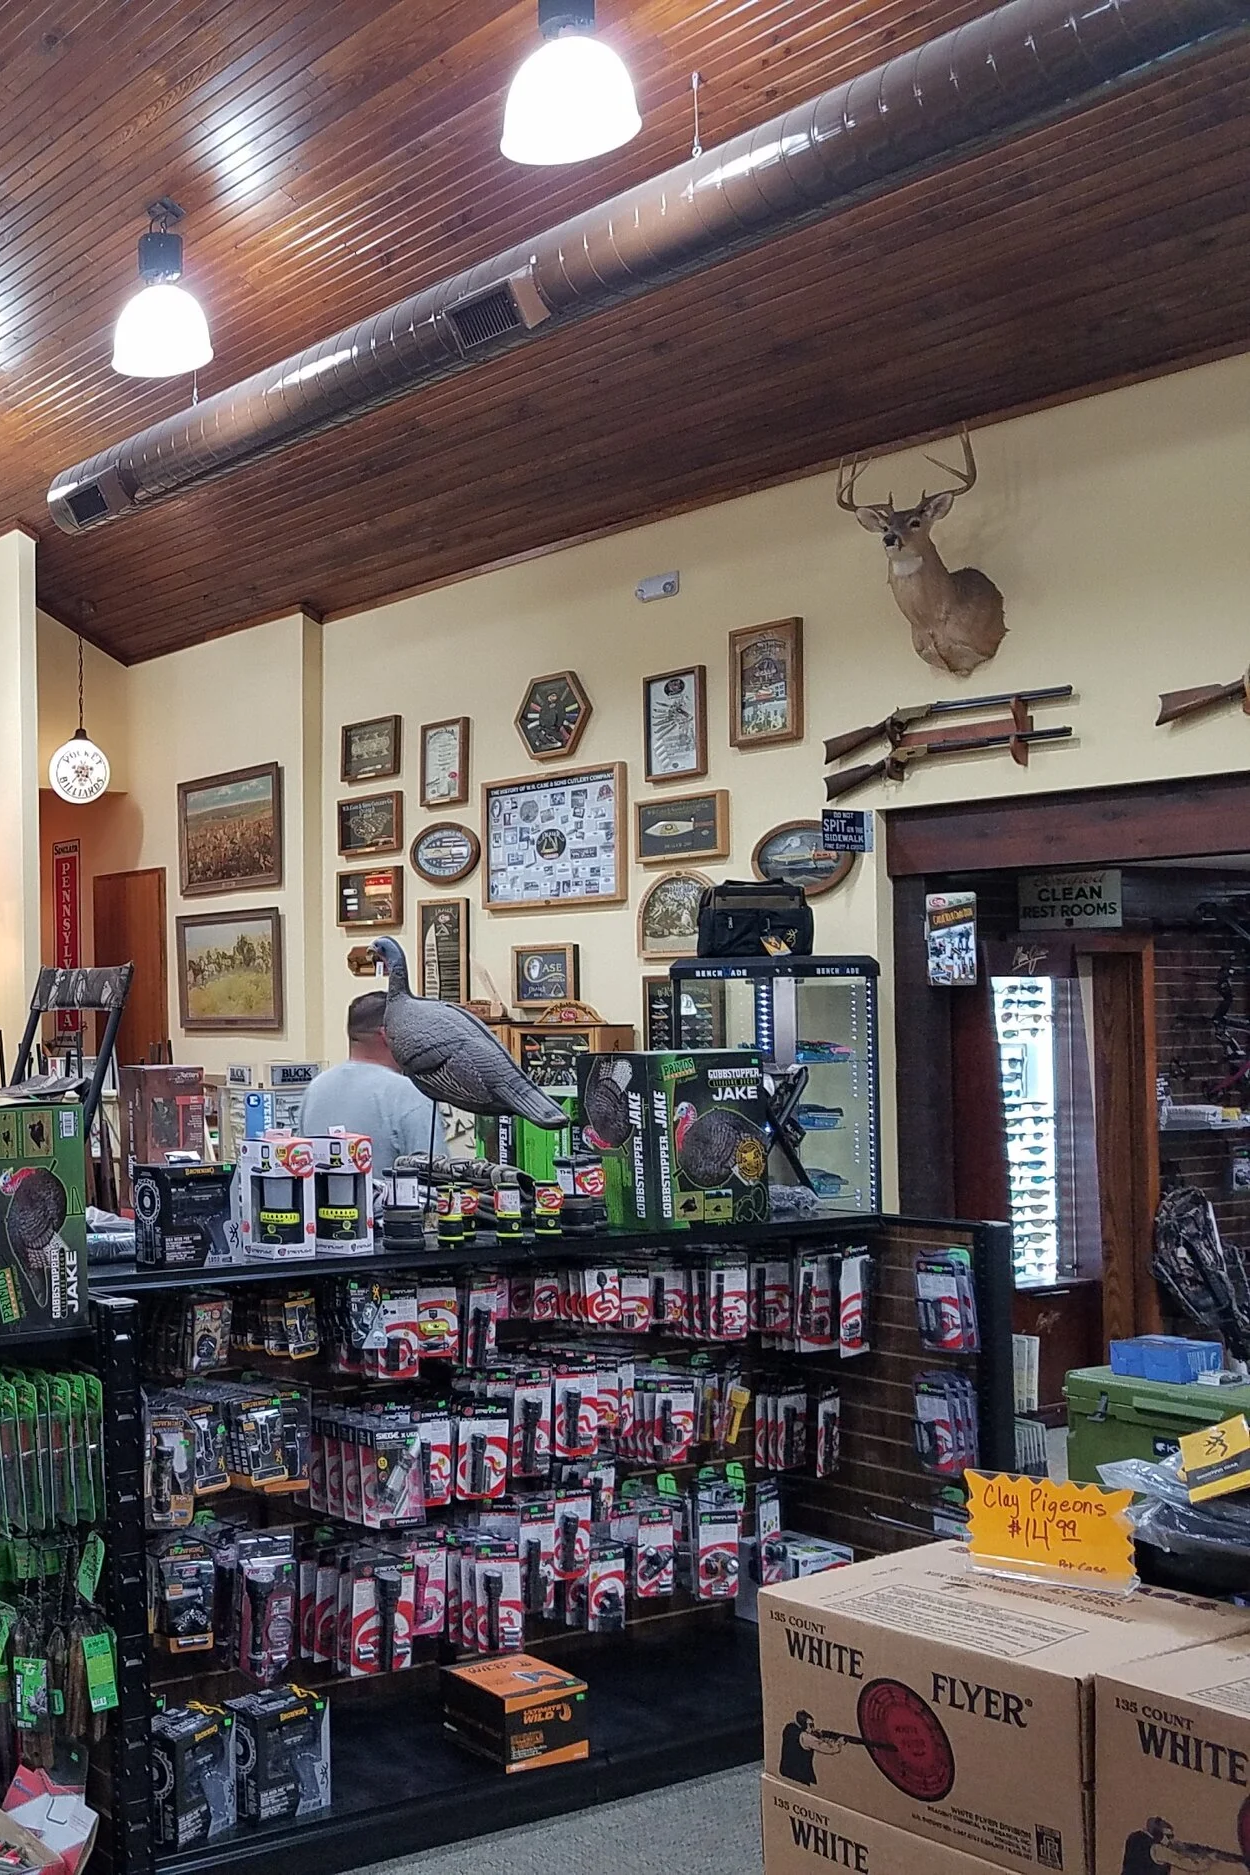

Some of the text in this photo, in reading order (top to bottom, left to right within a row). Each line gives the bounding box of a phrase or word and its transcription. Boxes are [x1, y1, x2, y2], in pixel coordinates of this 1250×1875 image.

[60, 776, 105, 797] BILLIARDS
[568, 776, 589, 785] CUTLERY
[590, 773, 614, 781] COMPANY
[823, 818, 847, 832] SPIT
[824, 833, 864, 843] SIDEWALK
[1038, 885, 1102, 901] CLEAN
[1022, 902, 1117, 919] REST ROOMS
[61, 862, 73, 1028] PENNSYLVA
[281, 1067, 312, 1078] BUCK
[664, 1059, 694, 1074] PRIMOS
[712, 1087, 758, 1101] JAKE
[628, 1091, 646, 1219] GOBBSTOPPER JAKE
[653, 1090, 672, 1219] GOBBSTOPPER JAKE
[51, 1247, 61, 1319] GOBBSTOPPER
[66, 1250, 79, 1313] JAKE
[983, 1484, 1107, 1523] Clay Pigeons
[769, 1609, 827, 1636] 135 COUNT
[784, 1627, 865, 1680] WHITE
[523, 1703, 562, 1715] ULTIMATE
[523, 1709, 555, 1725] WILD
[1115, 1697, 1194, 1731] 135 COUNT
[1135, 1719, 1249, 1787] WHITE
[773, 1796, 830, 1827] 135 COUNT
[950, 1805, 1032, 1838] WHITE FLYER DIVISION
[789, 1815, 869, 1875] WHITE
